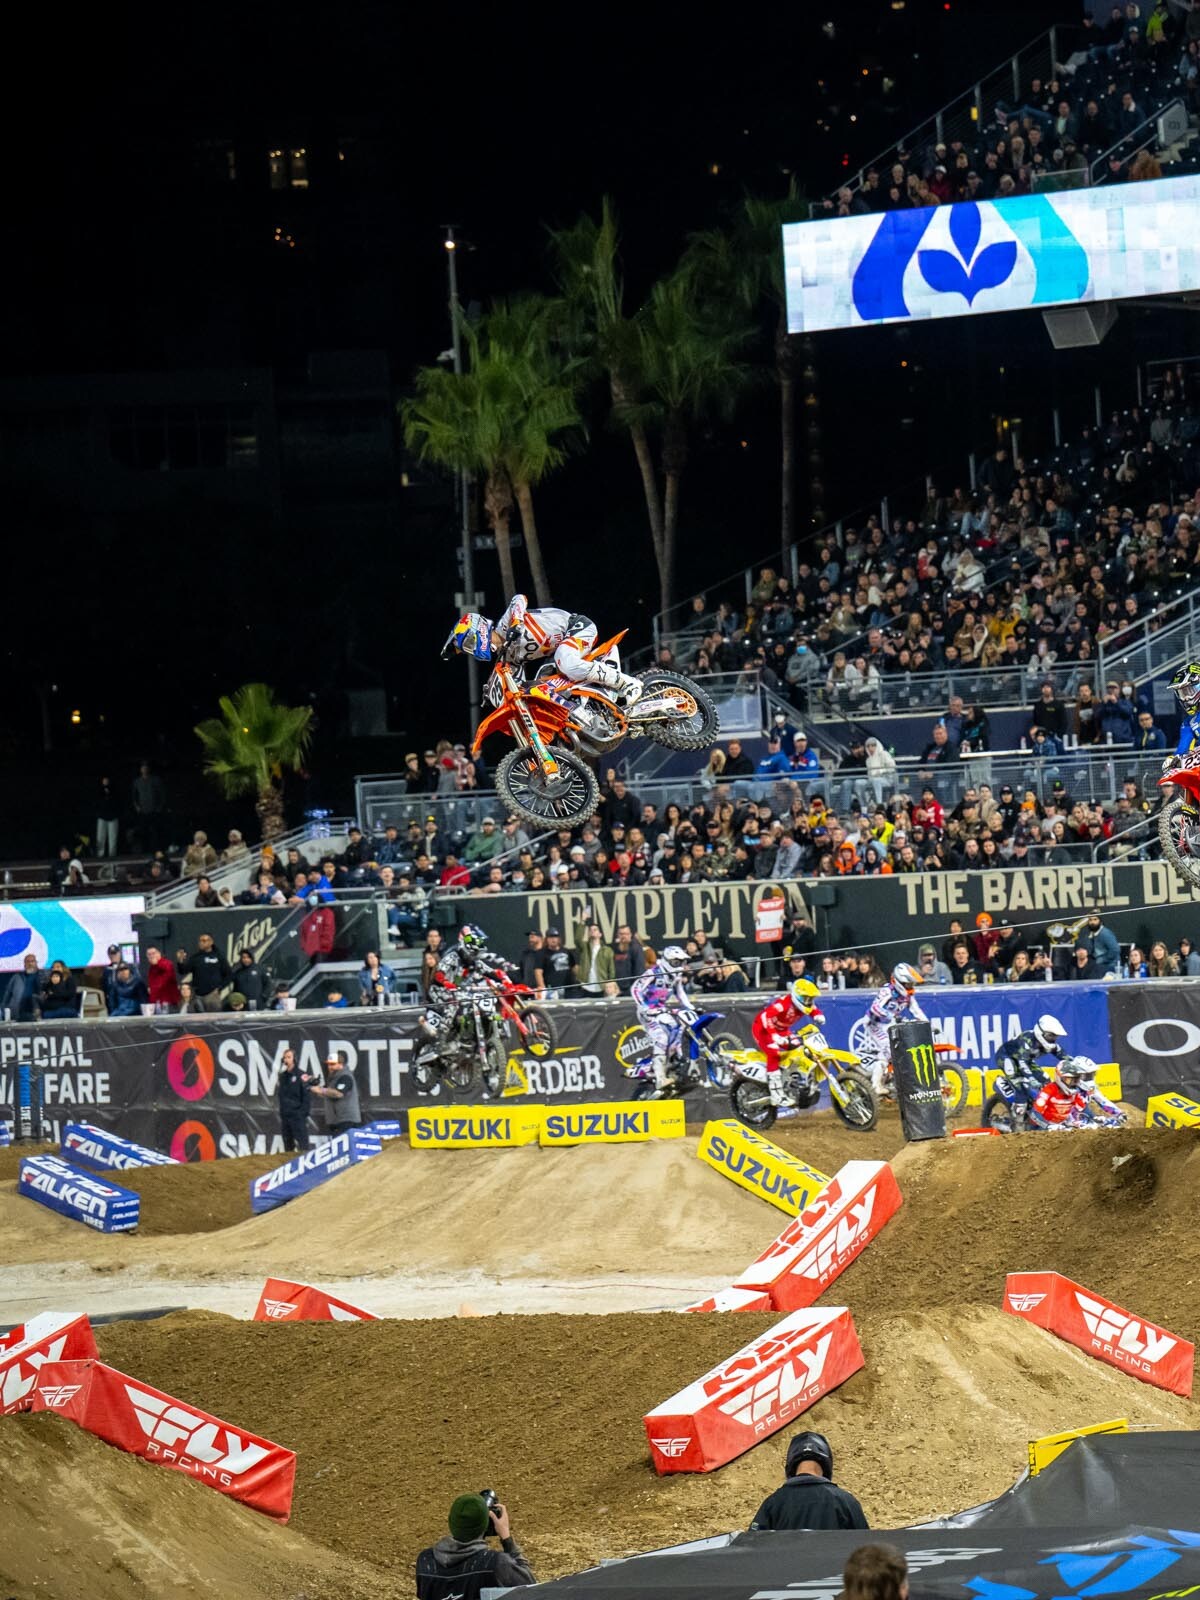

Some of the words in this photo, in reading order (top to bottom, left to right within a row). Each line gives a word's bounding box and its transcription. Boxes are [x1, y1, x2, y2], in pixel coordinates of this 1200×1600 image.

[899, 871, 970, 915] THE
[981, 866, 1129, 912] BARREL
[0, 1035, 93, 1068] PECIAL
[930, 1014, 1023, 1060] MAHA
[0, 1072, 111, 1104] FARE
[742, 1065, 759, 1077] 41
[909, 1090, 942, 1100] MONSTE
[416, 1118, 511, 1141] SUZUKI
[546, 1111, 649, 1139] SUZUKI
[65, 1132, 150, 1170] FALKE
[254, 1133, 350, 1198] FALKEN
[326, 1154, 351, 1174] TIRES
[707, 1136, 809, 1211] SUZUKI
[21, 1166, 108, 1219] FALKEN
[83, 1214, 104, 1230] TIRES
[790, 1184, 877, 1279] FLY
[819, 1231, 869, 1285] RACING
[1074, 1291, 1178, 1363] FLY
[0, 1335, 68, 1407] LY
[717, 1331, 834, 1425] FLY
[1091, 1338, 1152, 1373] RACING
[124, 1384, 271, 1475] FLY
[754, 1383, 820, 1435] RACING
[146, 1440, 233, 1486] RACING
